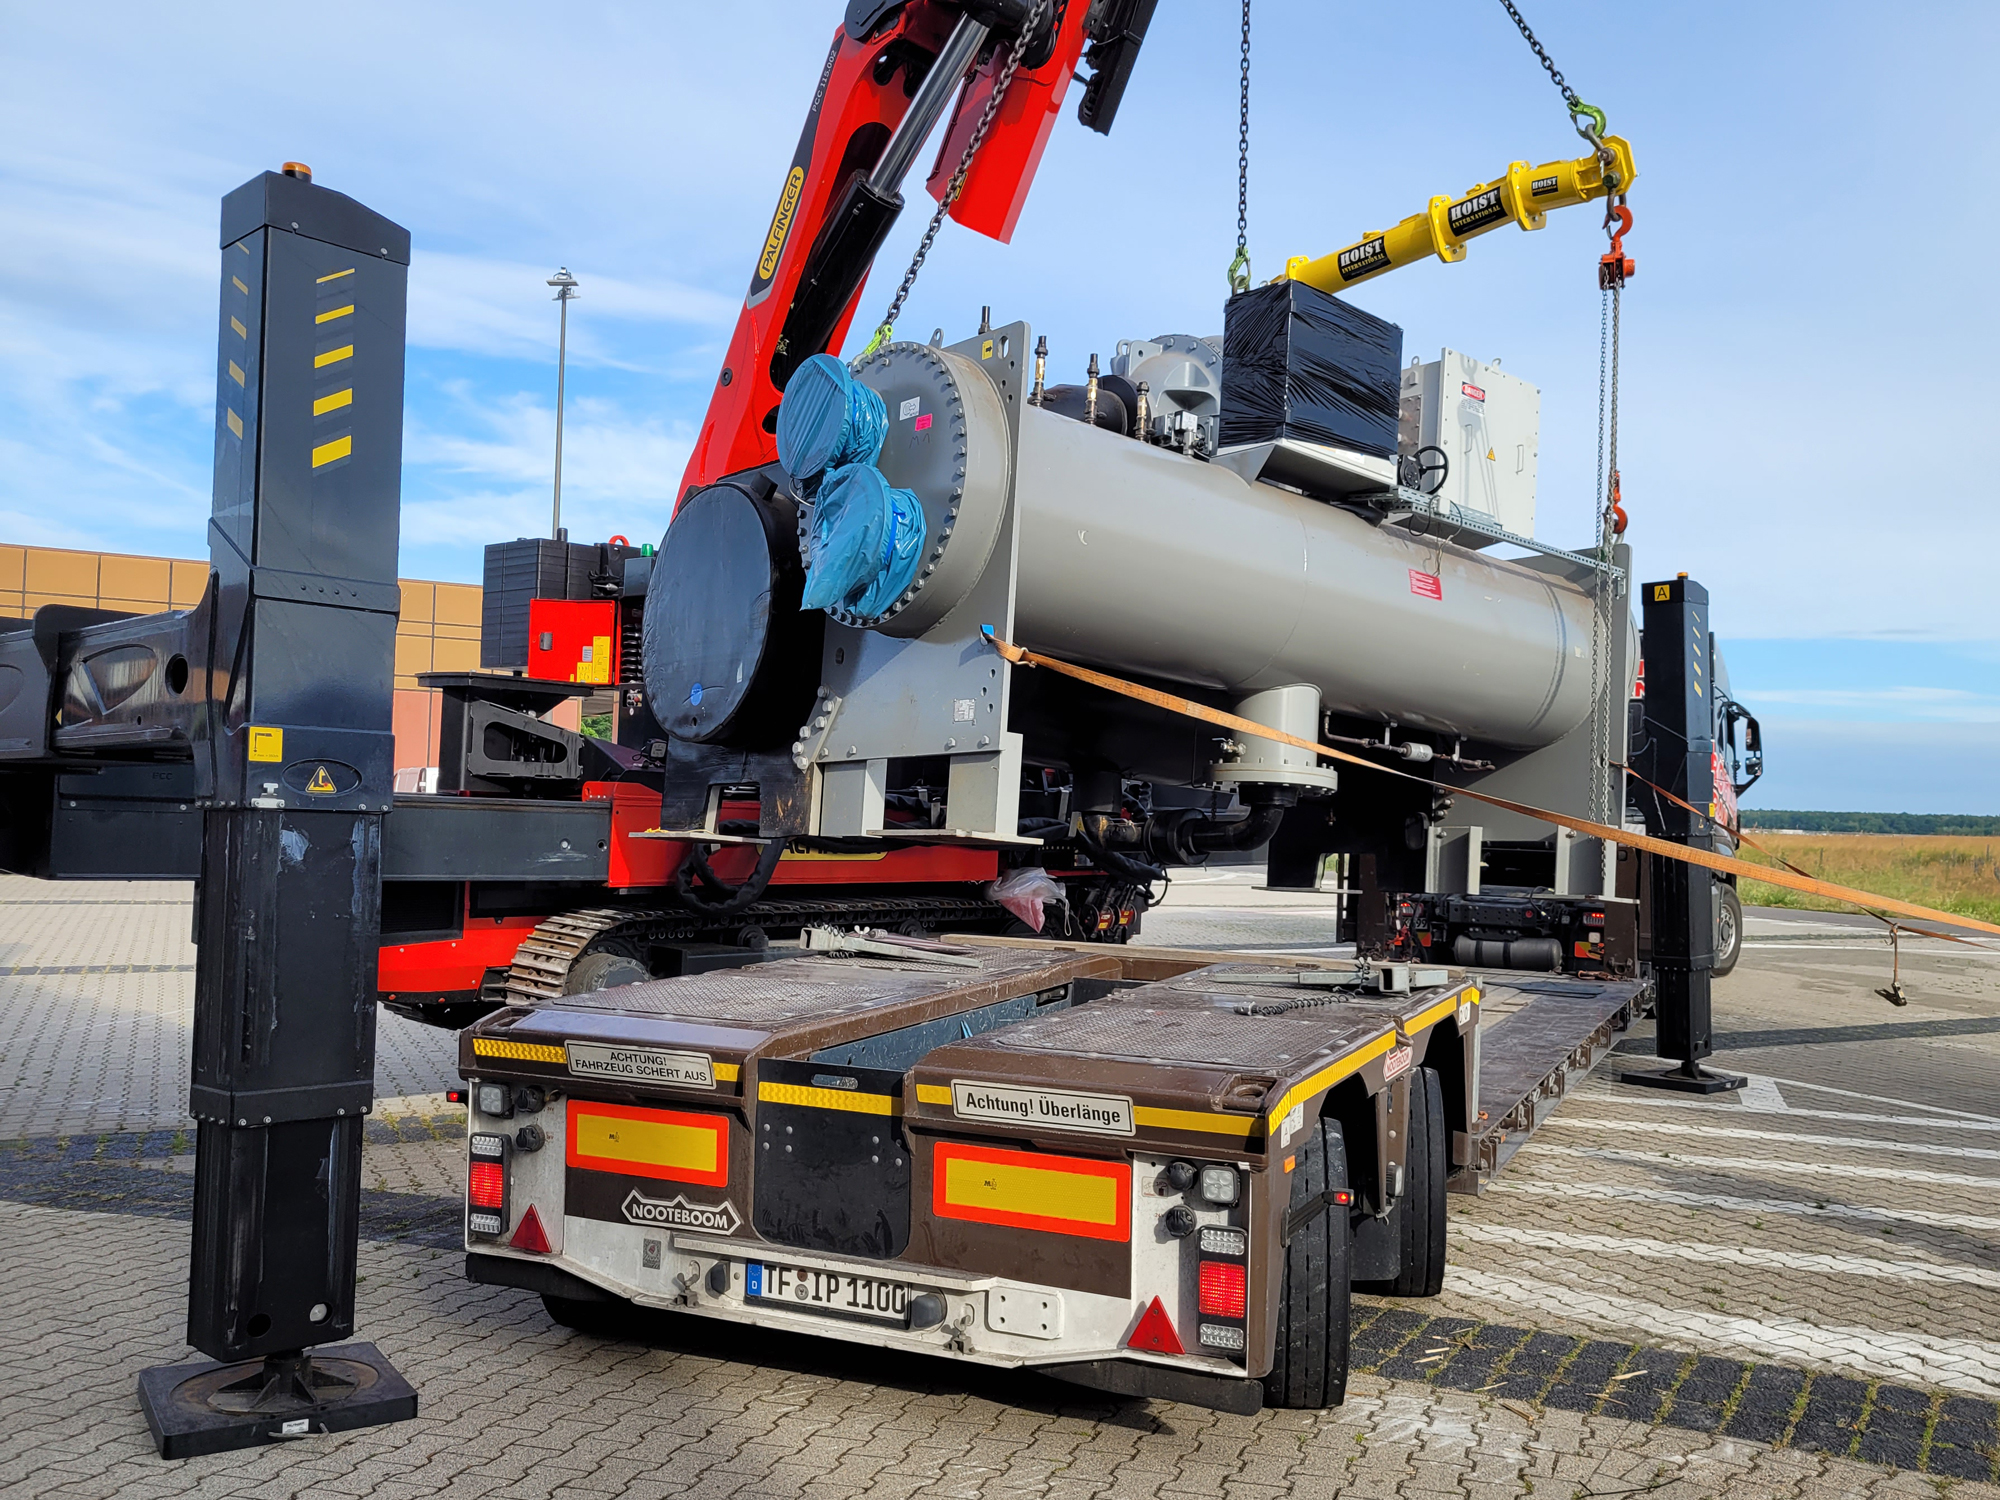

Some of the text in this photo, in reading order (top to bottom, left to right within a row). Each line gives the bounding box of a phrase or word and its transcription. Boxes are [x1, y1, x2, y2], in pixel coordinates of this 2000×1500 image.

[1532, 177, 1557, 190] HOIST
[1450, 190, 1498, 221] HOIST
[1452, 205, 1501, 228] INTERNATIONAL
[761, 173, 801, 272] PALFINGER
[1340, 239, 1382, 267] HOIST
[1341, 253, 1385, 274] INTERNATIONAL
[1656, 586, 1668, 600] A
[575, 1059, 707, 1081] FAHRZEUG SCHERT AUS
[610, 1052, 667, 1066] ACHTUNG!
[966, 1092, 1121, 1125] Achtung! Überlänge
[632, 1203, 728, 1229] NOOTEBOOM
[751, 1280, 758, 1290] D
[763, 1265, 906, 1314] TF IP 1100
